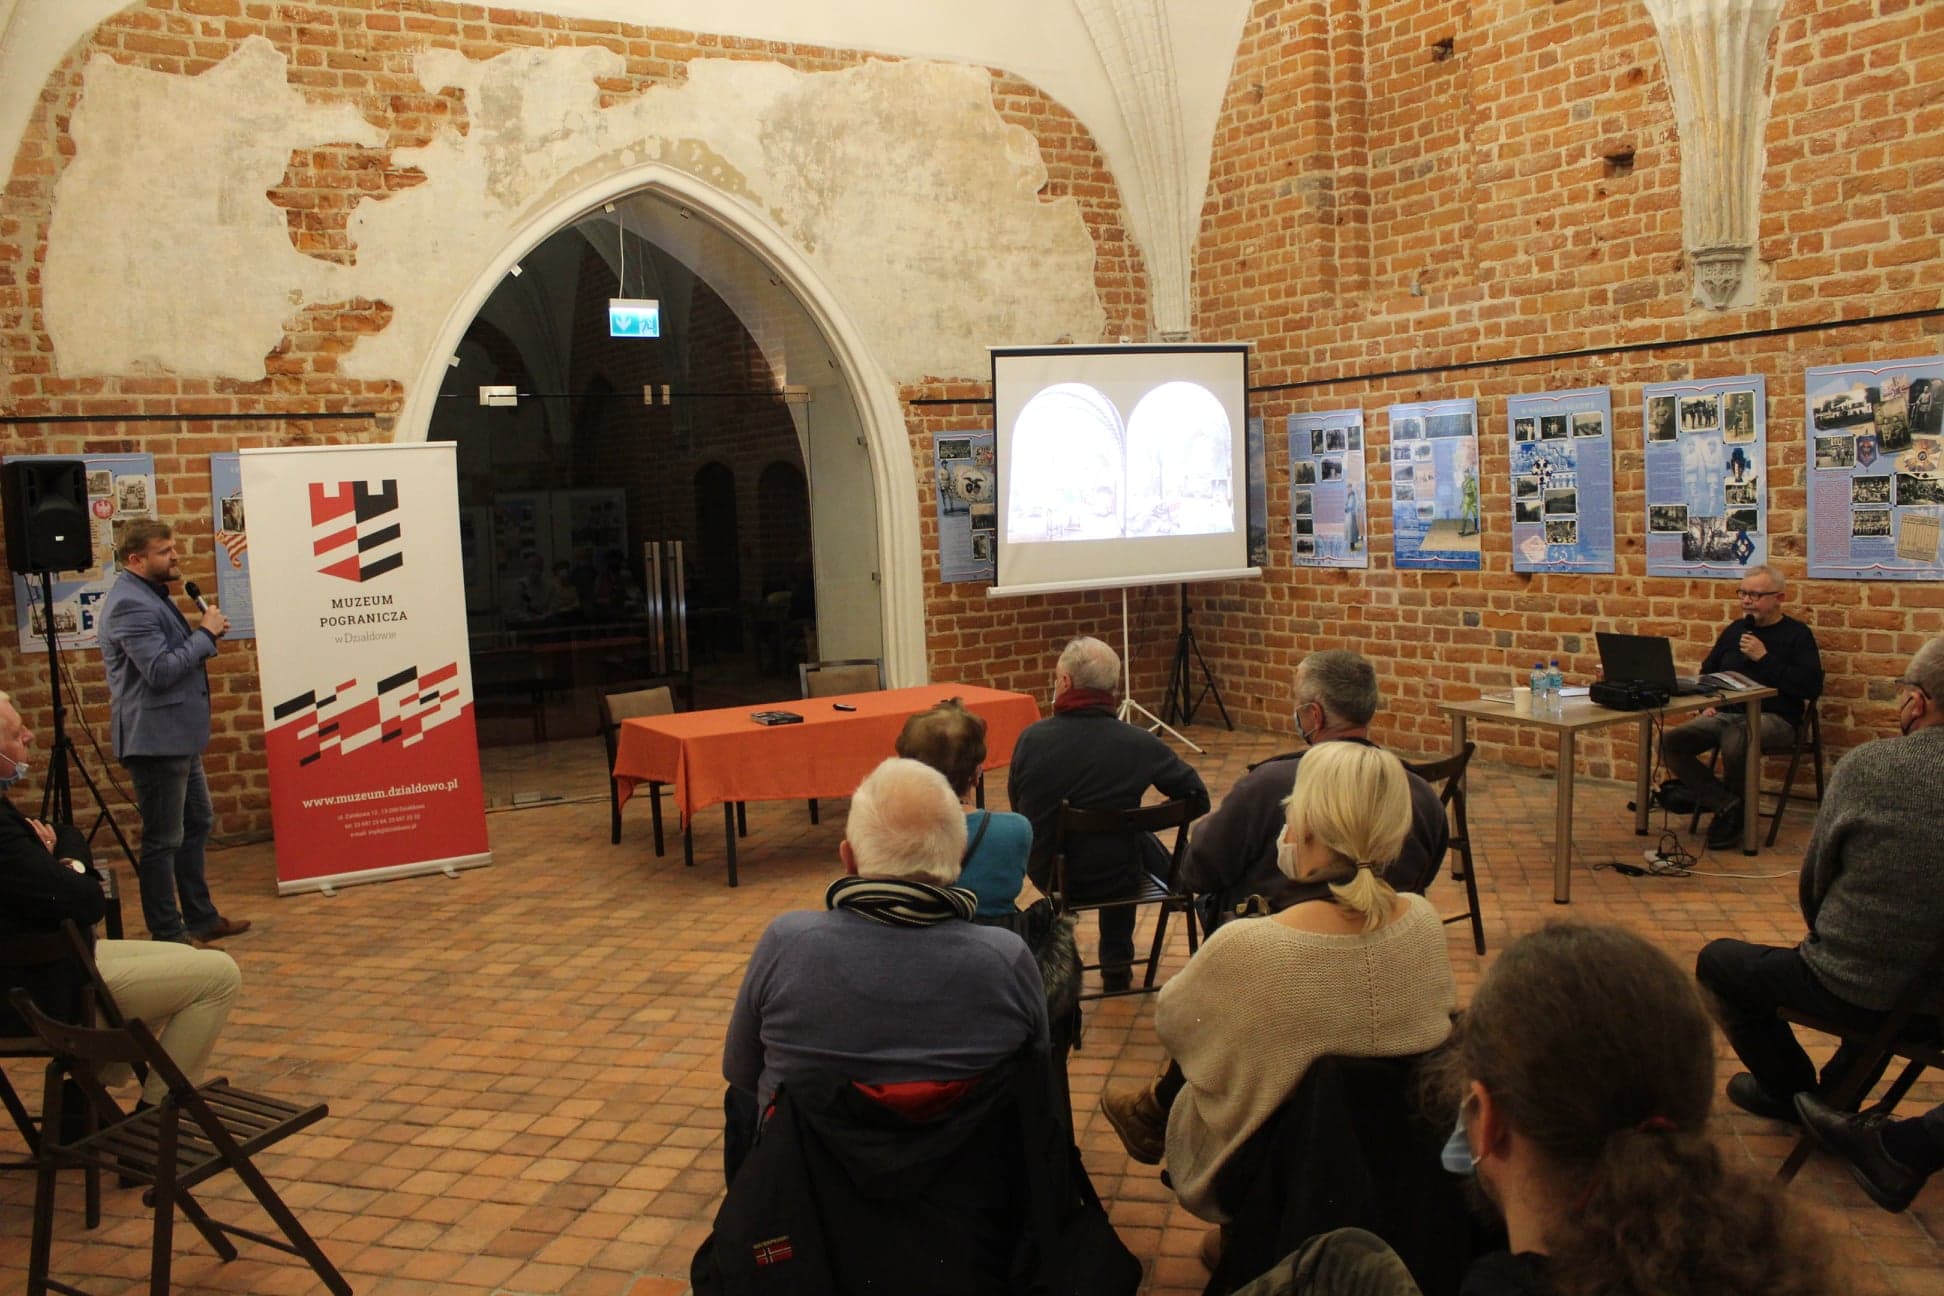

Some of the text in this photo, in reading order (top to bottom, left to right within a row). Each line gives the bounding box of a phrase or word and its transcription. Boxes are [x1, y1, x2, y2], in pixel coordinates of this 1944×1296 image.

[331, 595, 393, 609] MUZEUM
[320, 611, 408, 628] POGRANICZA
[302, 778, 459, 809] www.muzeum.dzialdowo.pl
